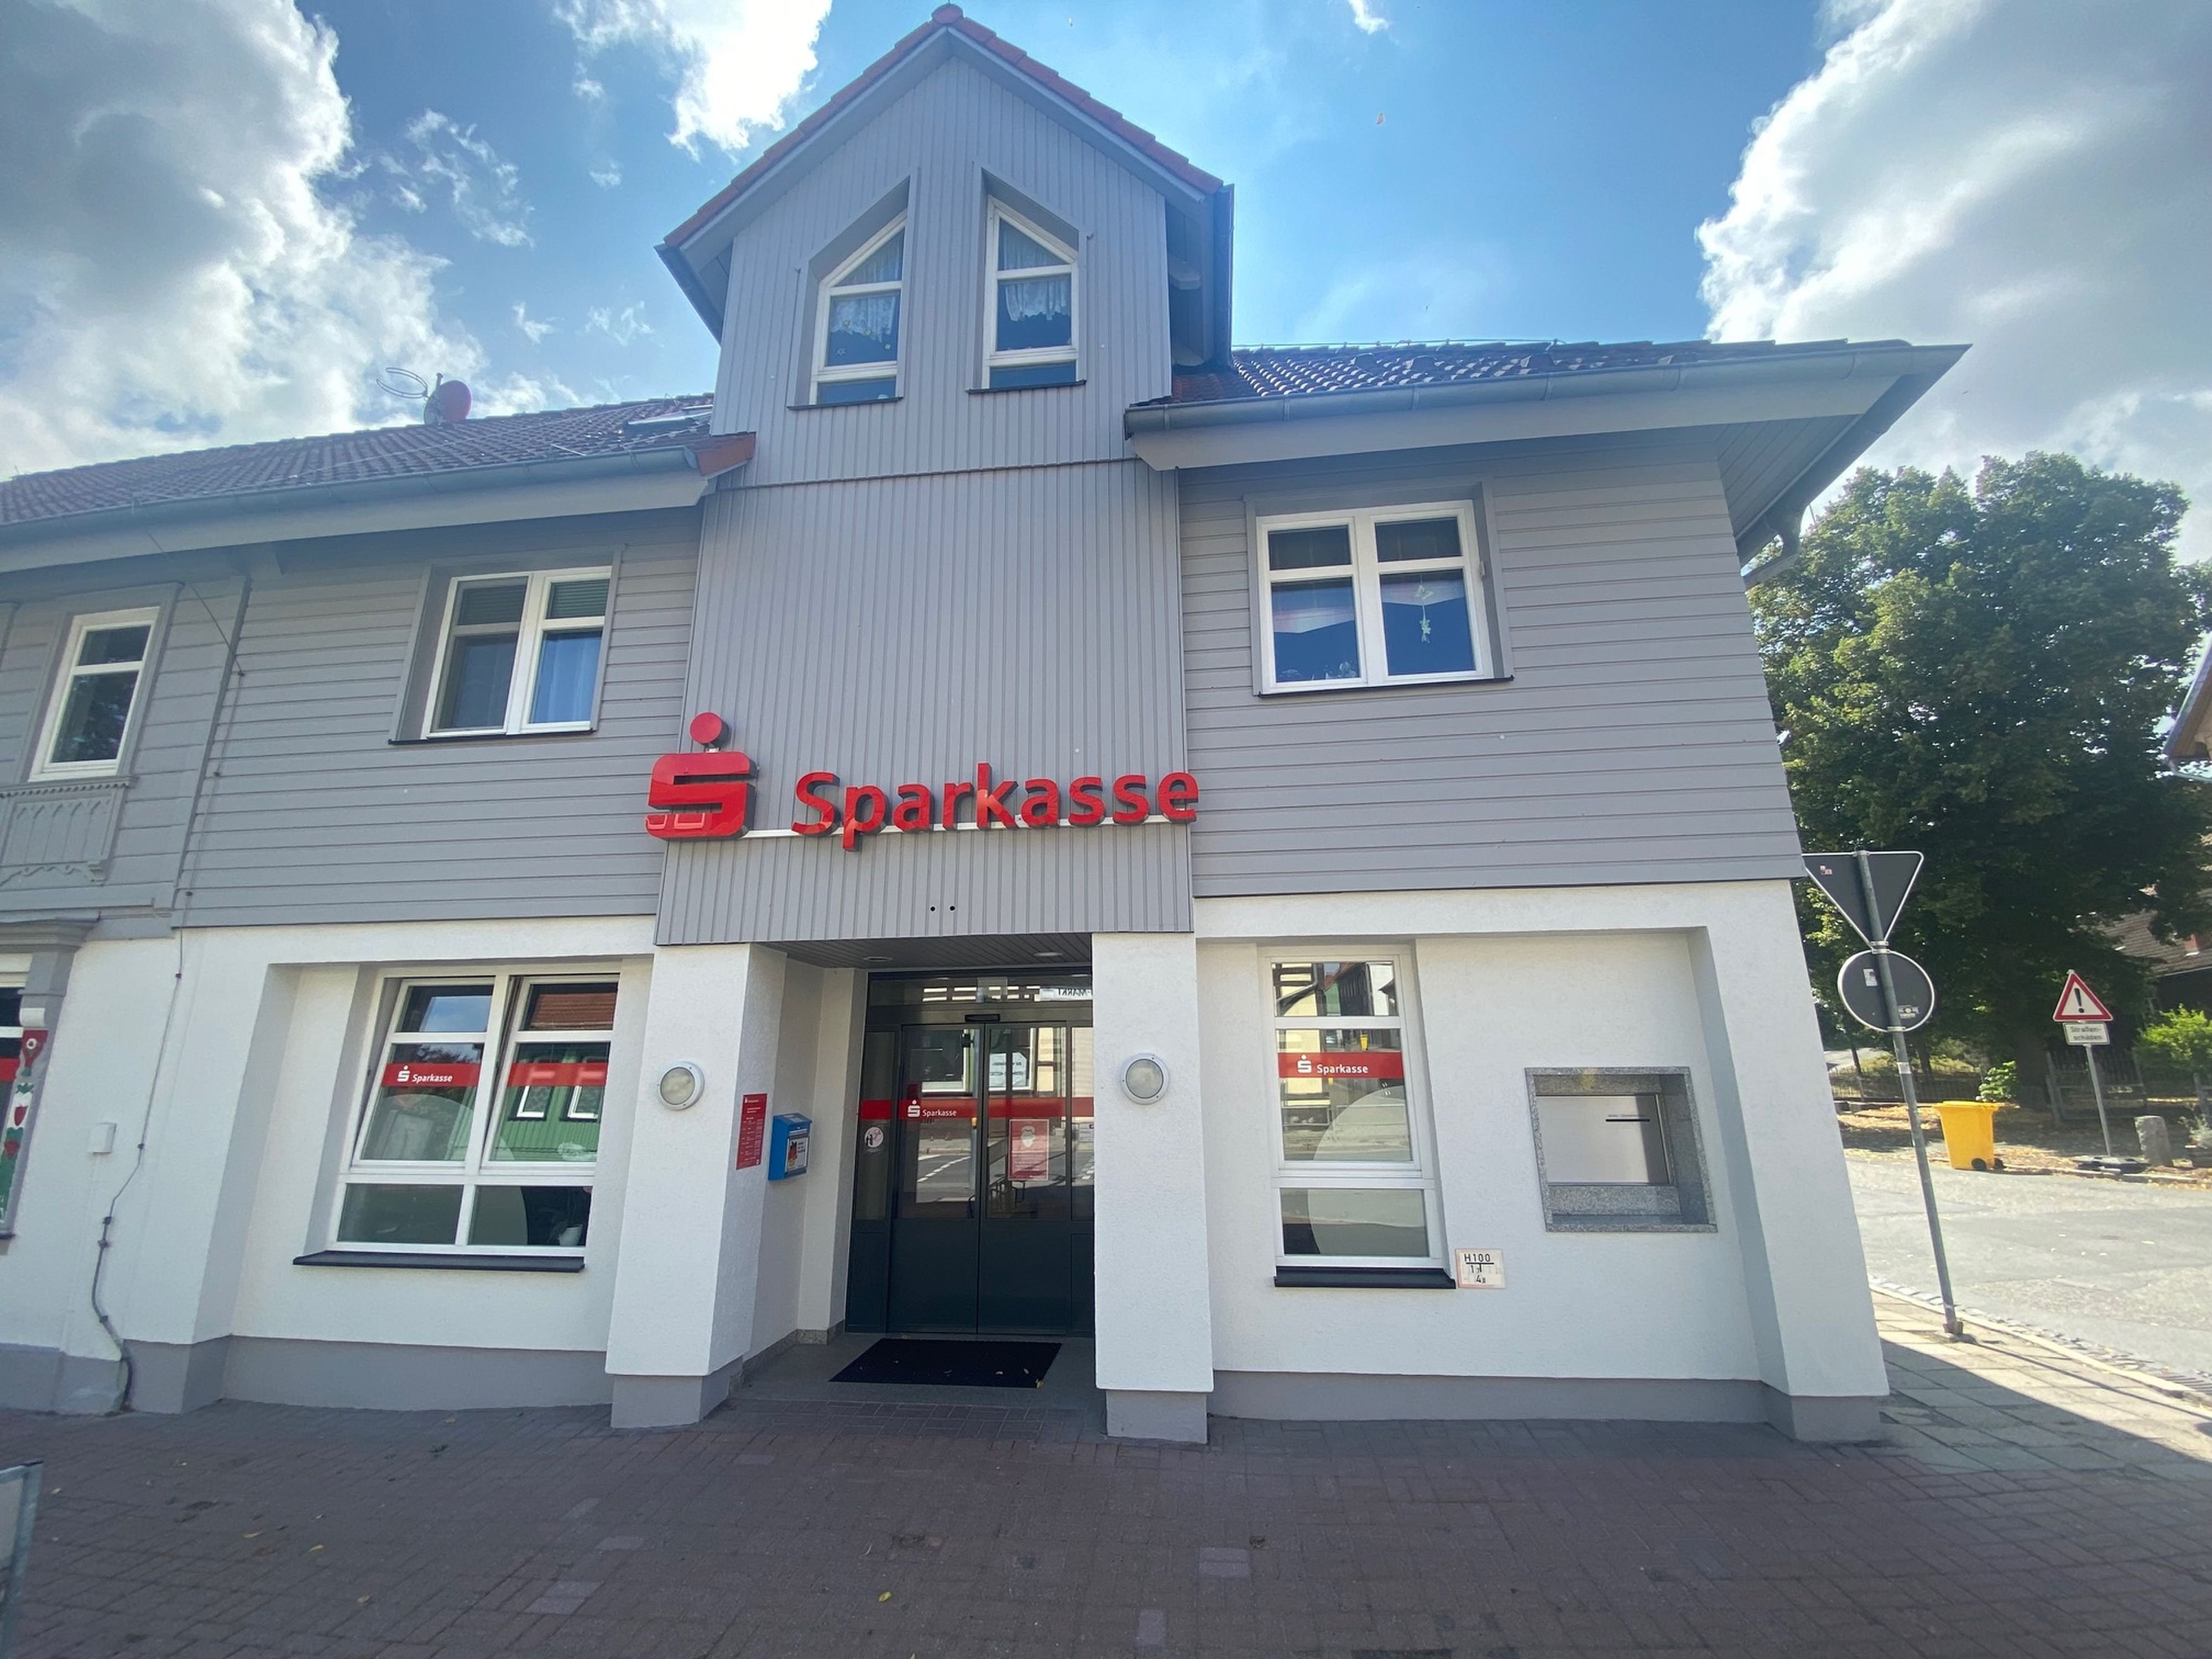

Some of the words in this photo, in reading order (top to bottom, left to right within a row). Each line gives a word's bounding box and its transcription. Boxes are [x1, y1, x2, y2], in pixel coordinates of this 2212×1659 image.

[791, 762, 1199, 852] Sparkasse
[1316, 1063, 1369, 1076] Sparkasse
[412, 1073, 453, 1084] Sparkasse
[922, 1109, 957, 1118] Sparkasse
[1464, 1253, 1491, 1262] H100
